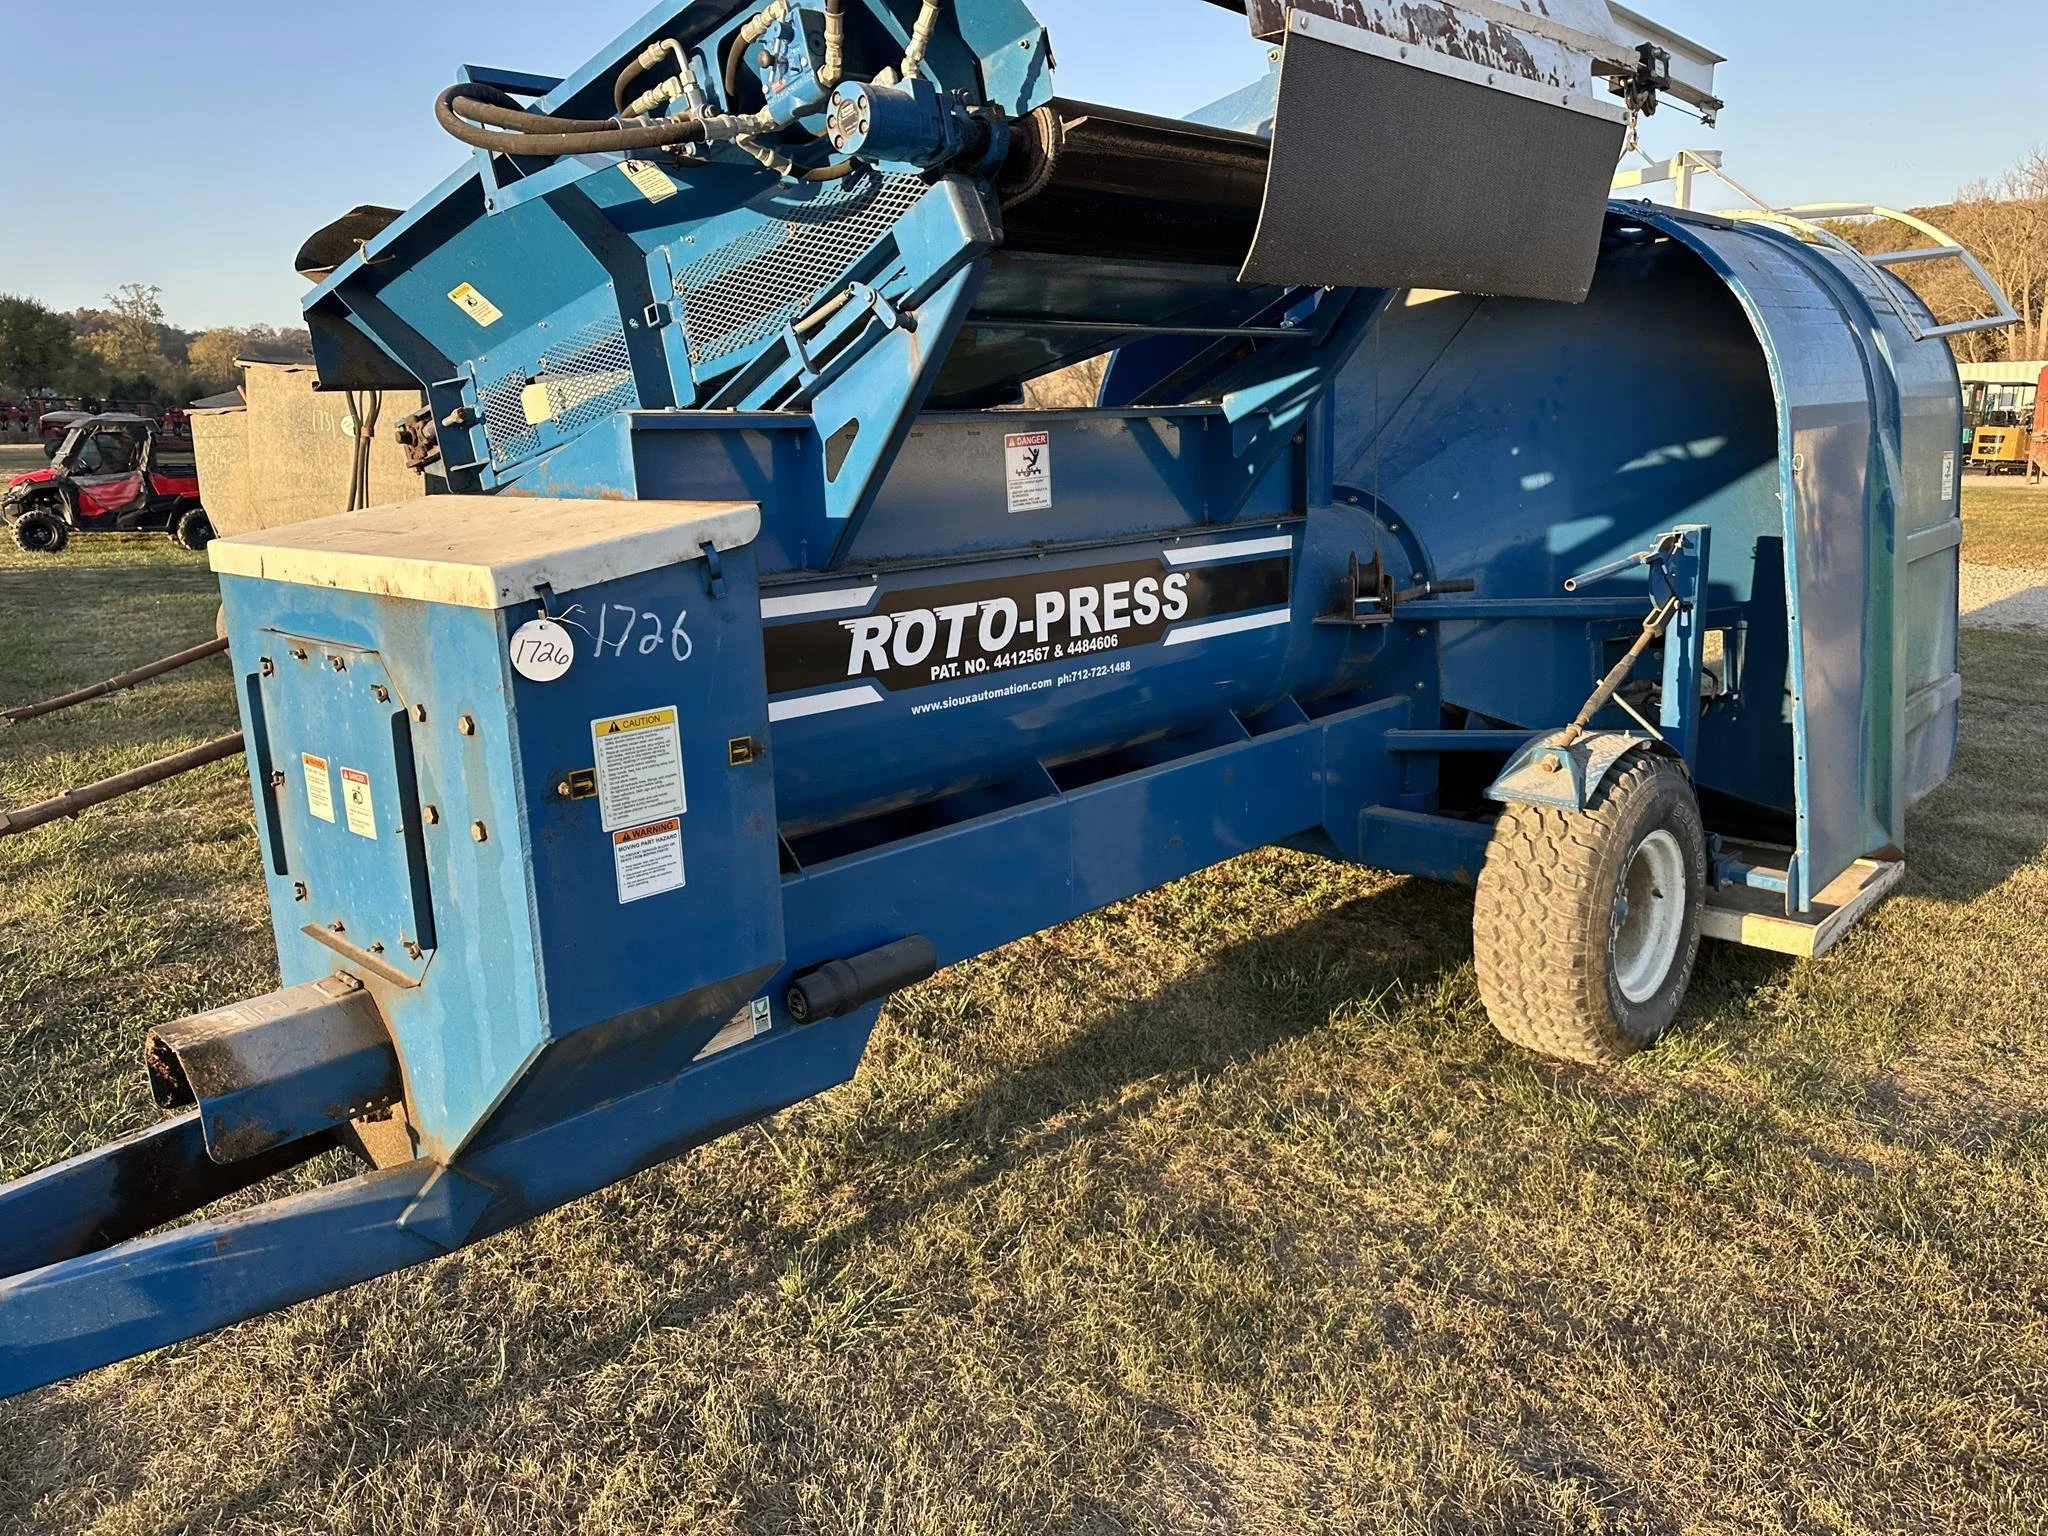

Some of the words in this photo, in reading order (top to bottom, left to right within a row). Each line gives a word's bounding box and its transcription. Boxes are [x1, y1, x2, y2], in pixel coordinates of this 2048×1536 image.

[1016, 434, 1046, 446] DANGER
[593, 602, 693, 662] 1726
[516, 639, 570, 665] 1726
[930, 663, 961, 681] PAT.
[965, 658, 990, 675] NO.
[993, 645, 1050, 669] 4412567
[1054, 643, 1065, 659] &
[1067, 634, 1119, 655] 4484606
[911, 678, 1053, 715] www.siouxautomation.com
[1057, 660, 1132, 688] ph:712-722-1488
[622, 714, 662, 729] CAUTION
[632, 821, 675, 838] WARNING
[618, 843, 640, 852] MOVING
[640, 839, 655, 848] PART
[655, 833, 678, 843] HAZARD
